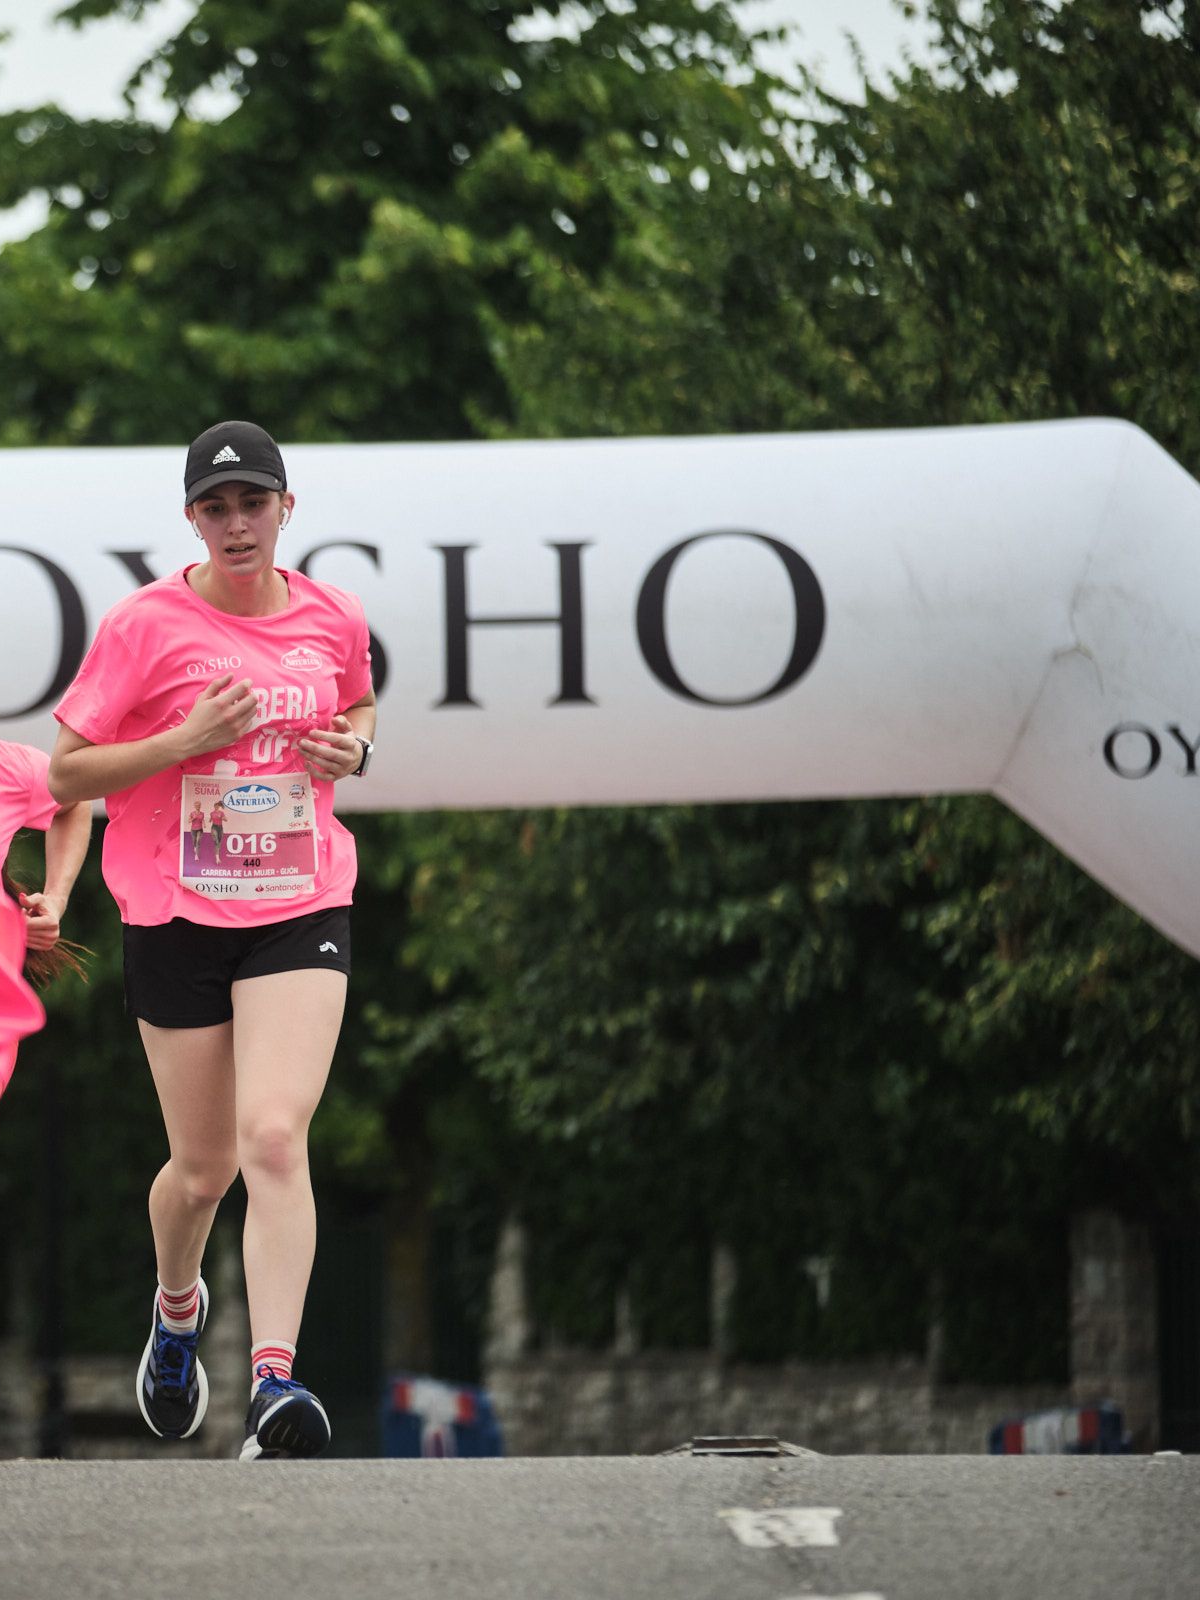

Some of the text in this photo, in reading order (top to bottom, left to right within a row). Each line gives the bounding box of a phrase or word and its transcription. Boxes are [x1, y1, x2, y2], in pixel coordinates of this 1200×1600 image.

[212, 455, 241, 465] adidas
[186, 655, 242, 677] OYSHO
[194, 787, 220, 796] SUMA
[227, 795, 277, 806] ASTURIANA
[226, 833, 277, 855] 016
[242, 858, 261, 867] 440
[200, 868, 232, 877] CARRERA
[233, 869, 242, 877] DE
[243, 869, 252, 877] LA
[253, 868, 275, 877] MUJER
[195, 883, 239, 893] OYSHO
[265, 883, 304, 893] Santander
